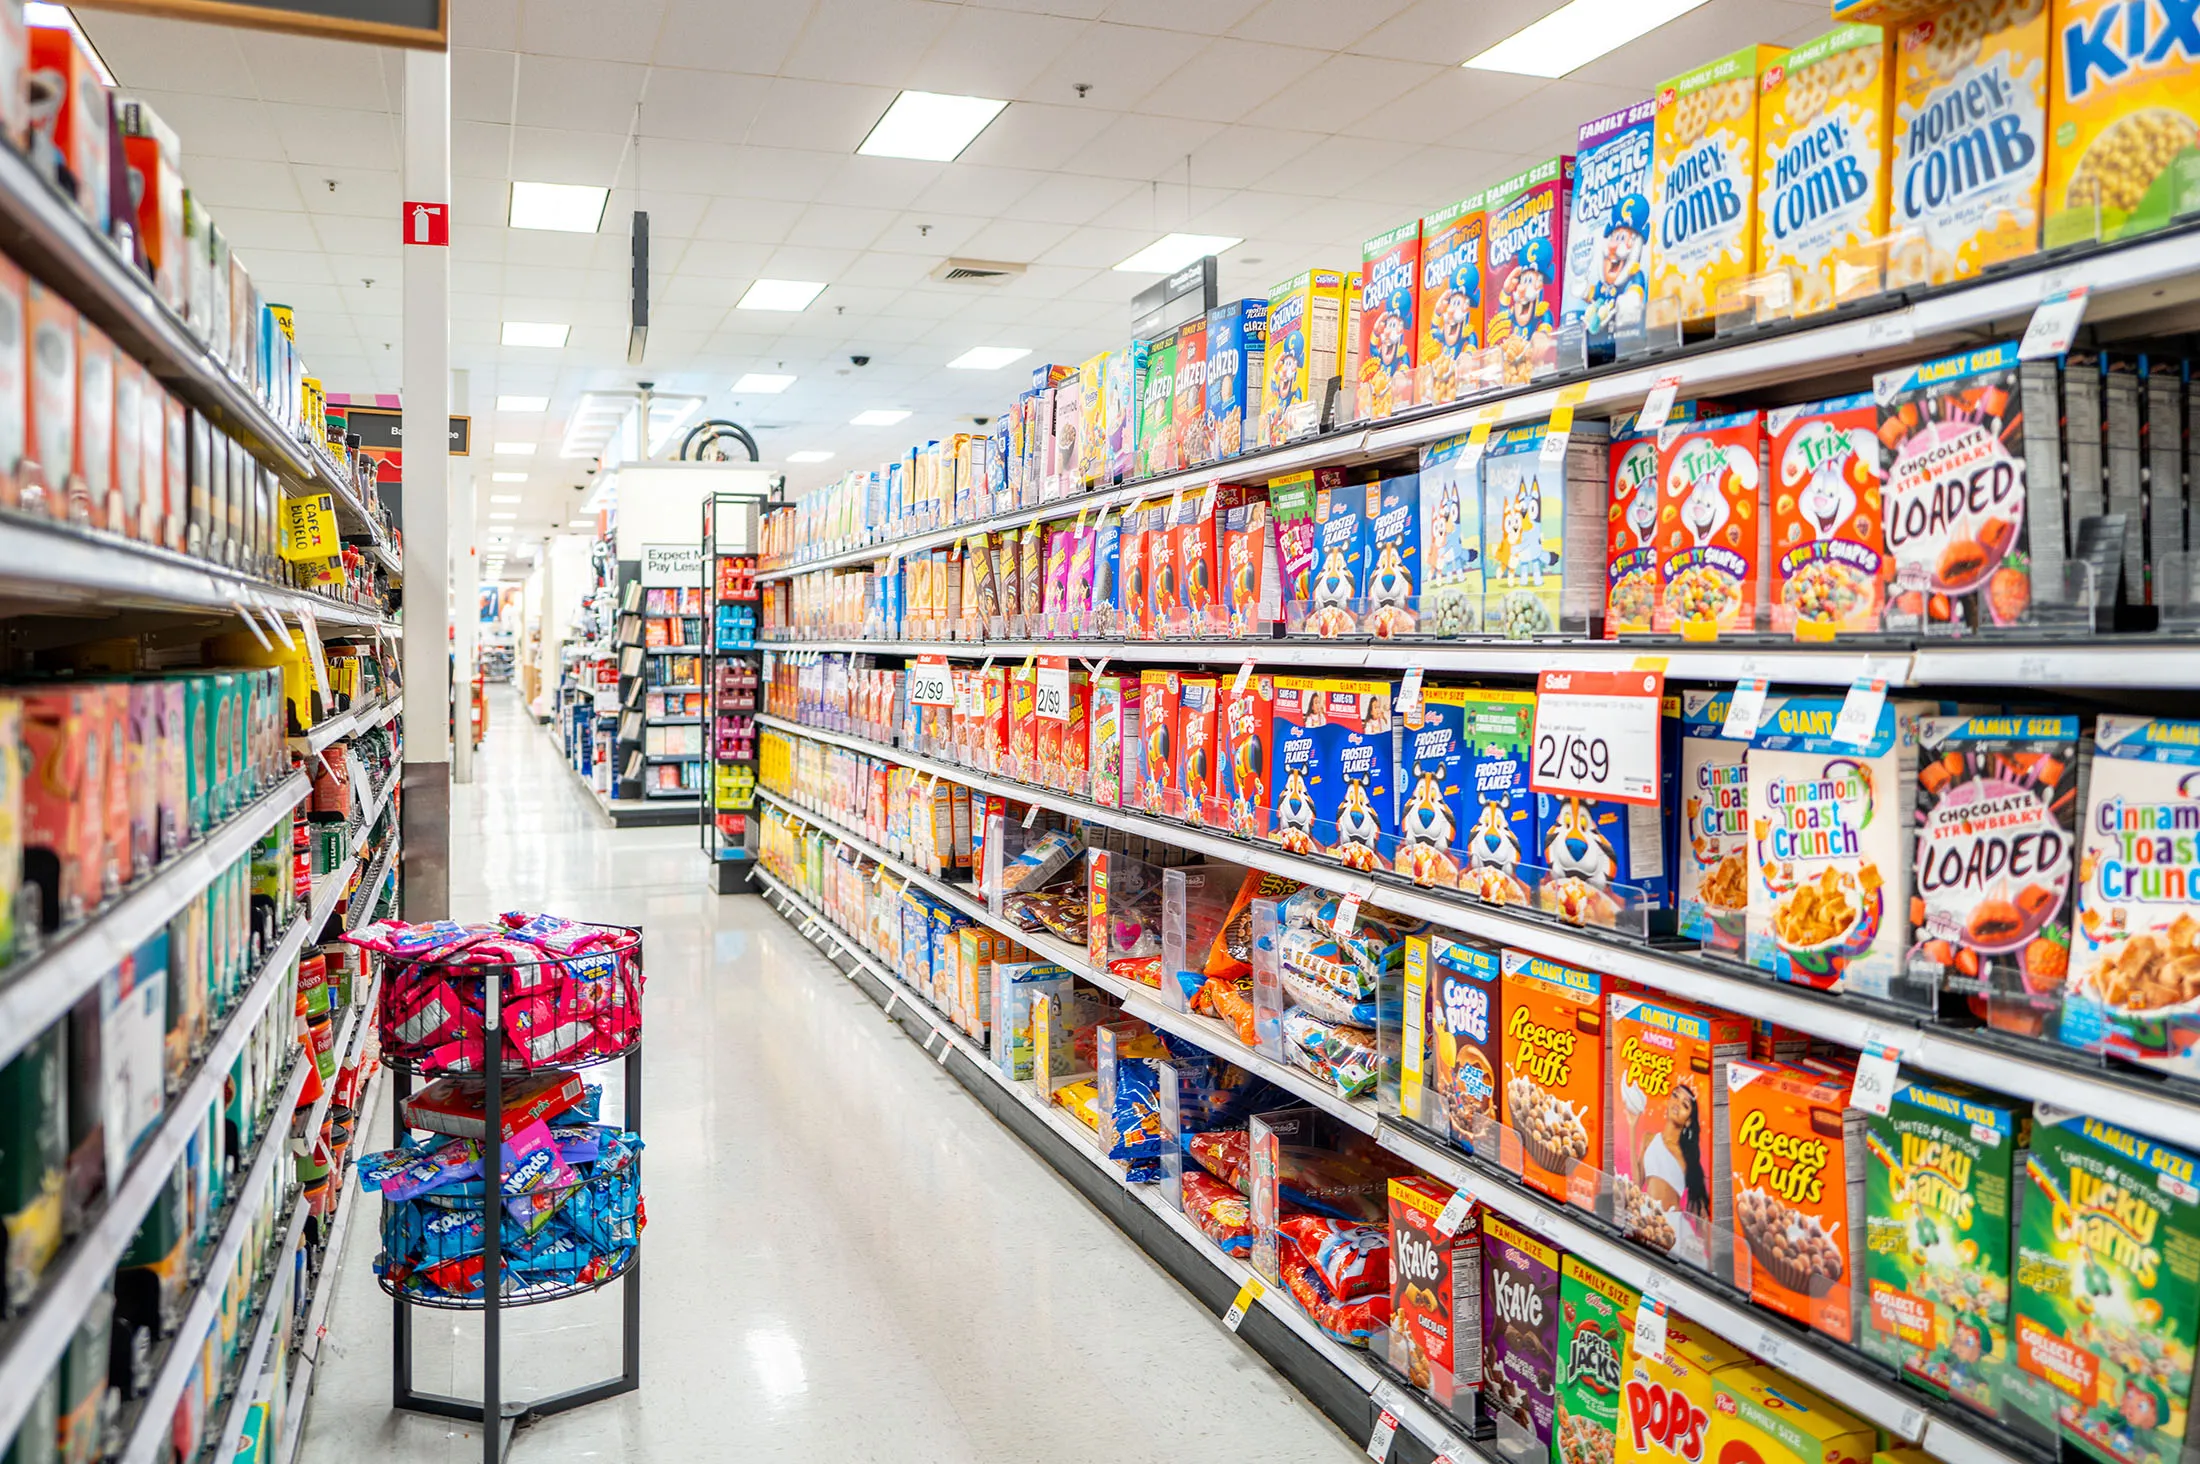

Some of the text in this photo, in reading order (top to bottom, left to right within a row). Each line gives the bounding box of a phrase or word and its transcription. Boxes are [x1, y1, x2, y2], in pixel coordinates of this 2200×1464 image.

[1788, 29, 1856, 68] FAMILY SIZE
[1679, 60, 1736, 91] FAMILY SIZE
[1579, 113, 1624, 141] FAMILY
[1579, 132, 1650, 196] ARCTIC
[1486, 160, 1557, 203] FAMILY SIZE
[1577, 169, 1644, 223] CRUNCH
[1423, 193, 1485, 228] FAMILY SIZE
[1488, 189, 1555, 242] Cinnamon
[1364, 222, 1418, 255] FAMILY SIZE
[1489, 211, 1550, 267] CRUNCH
[1423, 236, 1480, 290] CRUNCH
[1268, 273, 1310, 298] FAMILY SIZE
[1362, 260, 1414, 312] CRUNCH
[1270, 298, 1305, 335] CRUNCH
[1174, 361, 1207, 395] GLAZED
[1207, 348, 1239, 385] GLAZED
[1918, 347, 2002, 383] FAMILY SIZE
[1143, 375, 1173, 407] GLAZED
[1682, 438, 1729, 486] Trix
[1798, 423, 1853, 471] Trix
[1900, 430, 1983, 476] CHOCOLATE
[1374, 505, 1409, 532] FROSTED
[1891, 460, 2014, 546] LOADED
[290, 504, 308, 550] BUSTELO
[1322, 513, 1357, 536] FROSTED
[1323, 526, 1353, 547] FLAKES
[1375, 519, 1405, 543] FLAKES
[649, 550, 688, 562] Expect
[649, 562, 671, 573] Pay
[1705, 548, 1746, 575] SHAPES
[1829, 540, 1879, 571] SHAPES
[915, 680, 944, 701] 2/$9
[1285, 679, 1314, 689] GIANT SIZE
[1340, 682, 1372, 693] GIANT SIZE
[1425, 690, 1465, 701] FAMILY SIZE
[1545, 673, 1572, 690] Sale!
[1037, 688, 1061, 714] 2/$9
[1228, 695, 1255, 725] FROOT
[1230, 715, 1255, 740] LOOPS
[1414, 728, 1453, 748] FROSTED
[1778, 709, 1833, 735] GIANT
[1968, 717, 2061, 737] FAMILY SIZE
[1283, 738, 1313, 753] FROSTED
[1285, 750, 1309, 765] FLAKES
[1341, 745, 1373, 761] FROSTED
[1415, 743, 1448, 760] FLAKES
[1538, 733, 1609, 784] 2/$9
[1343, 758, 1370, 773] FLAKES
[1475, 761, 1517, 779] FROSTED
[1476, 775, 1513, 792] FLAKES
[1770, 776, 1858, 803] Cinnamon
[1785, 801, 1840, 829] Toast
[1939, 795, 2034, 824] CHOCOLATE
[1775, 821, 1859, 856] Crunch
[1922, 831, 2063, 891] LOADED
[1450, 946, 1490, 969] FAMILY SIZE
[1531, 959, 1592, 989] GIANT SIZE
[1444, 978, 1488, 1017] Cocoa
[1446, 1006, 1488, 1042] Puffs
[1508, 1005, 1577, 1055] Reese's
[1639, 1006, 1701, 1038] FAMILY SIZE
[1642, 1030, 1676, 1050] ANGEL
[1515, 1043, 1571, 1087] Puffs
[1622, 1037, 1675, 1076] Reese's
[1627, 1064, 1671, 1096] Puffs
[529, 1099, 550, 1119] Trix
[1909, 1086, 1996, 1127] FAMILY SIZE
[1738, 1109, 1830, 1170] Reese's
[1893, 1119, 1981, 1156] LIMITED EDITION
[2083, 1118, 2194, 1182] FAMILY SIZE
[503, 1150, 550, 1193] Nerds
[1255, 1151, 1276, 1178] Trix
[1750, 1149, 1825, 1204] Puffs
[1902, 1132, 1972, 1192] Lucky
[2060, 1150, 2172, 1213] LIMITED EDITION
[1395, 1187, 1439, 1217] FAMILY SIZE
[1888, 1167, 1975, 1232] Charms
[2068, 1167, 2160, 1246] Lucky
[1454, 1236, 1479, 1247] CHOCOLATE
[1494, 1224, 1543, 1259] FAMILY SIZE
[2051, 1198, 2161, 1289] Charms
[1504, 1247, 1530, 1270] Kellogg's
[1573, 1265, 1630, 1306] FAMILY SIZE
[1585, 1292, 1612, 1316] Kellogg's
[1418, 1314, 1448, 1340] CHOCOLATE
[1578, 1330, 1611, 1356] APPLE
[2020, 1327, 2073, 1360] COLLECT
[1567, 1341, 1621, 1388] JACKS
[1634, 1368, 1649, 1382] CORN
[2030, 1346, 2092, 1387] CONNECT
[1715, 1392, 1737, 1416] Post
[1626, 1381, 1710, 1461] POPS
[1740, 1402, 1801, 1448] FAMILY SIZE
